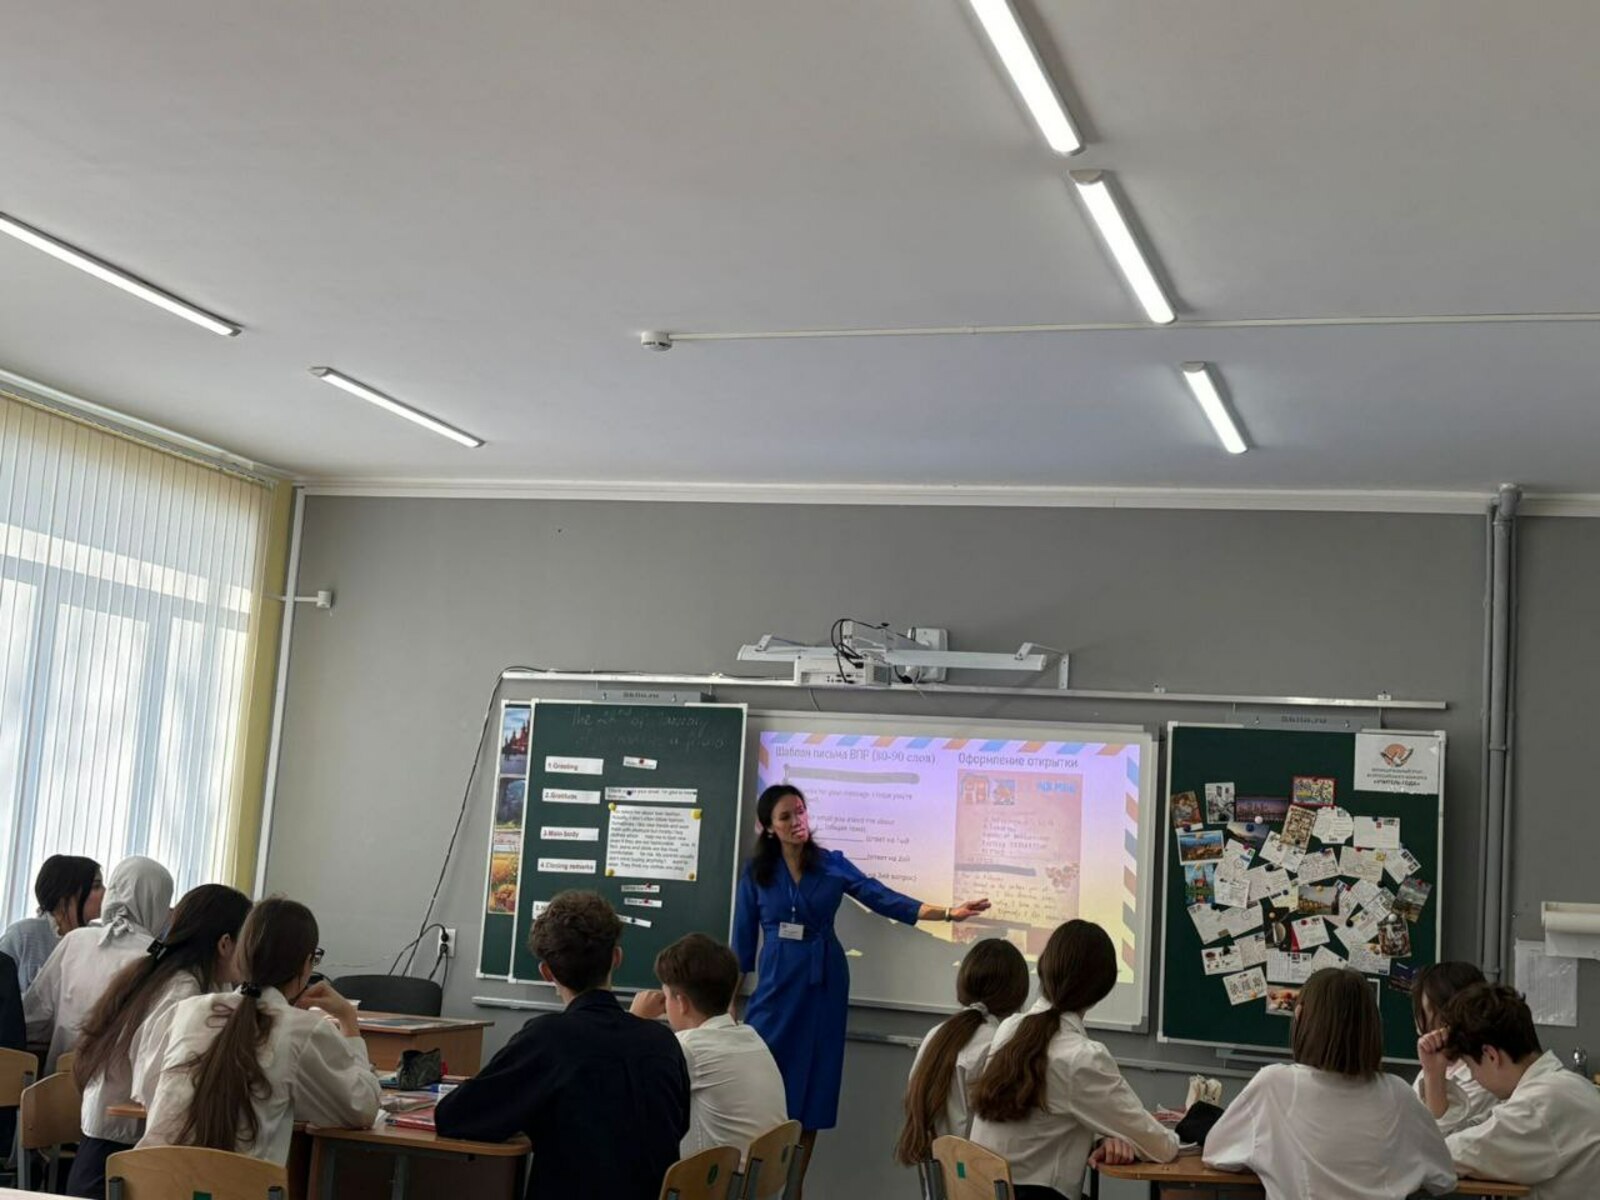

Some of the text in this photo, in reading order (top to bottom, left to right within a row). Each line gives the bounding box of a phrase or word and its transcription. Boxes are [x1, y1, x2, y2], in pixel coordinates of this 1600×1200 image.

[775, 747, 811, 759] Шаблон
[813, 750, 847, 761] письма
[849, 750, 869, 761] ВПР
[905, 753, 936, 765] слов)
[958, 752, 1079, 769] Оформление открытки
